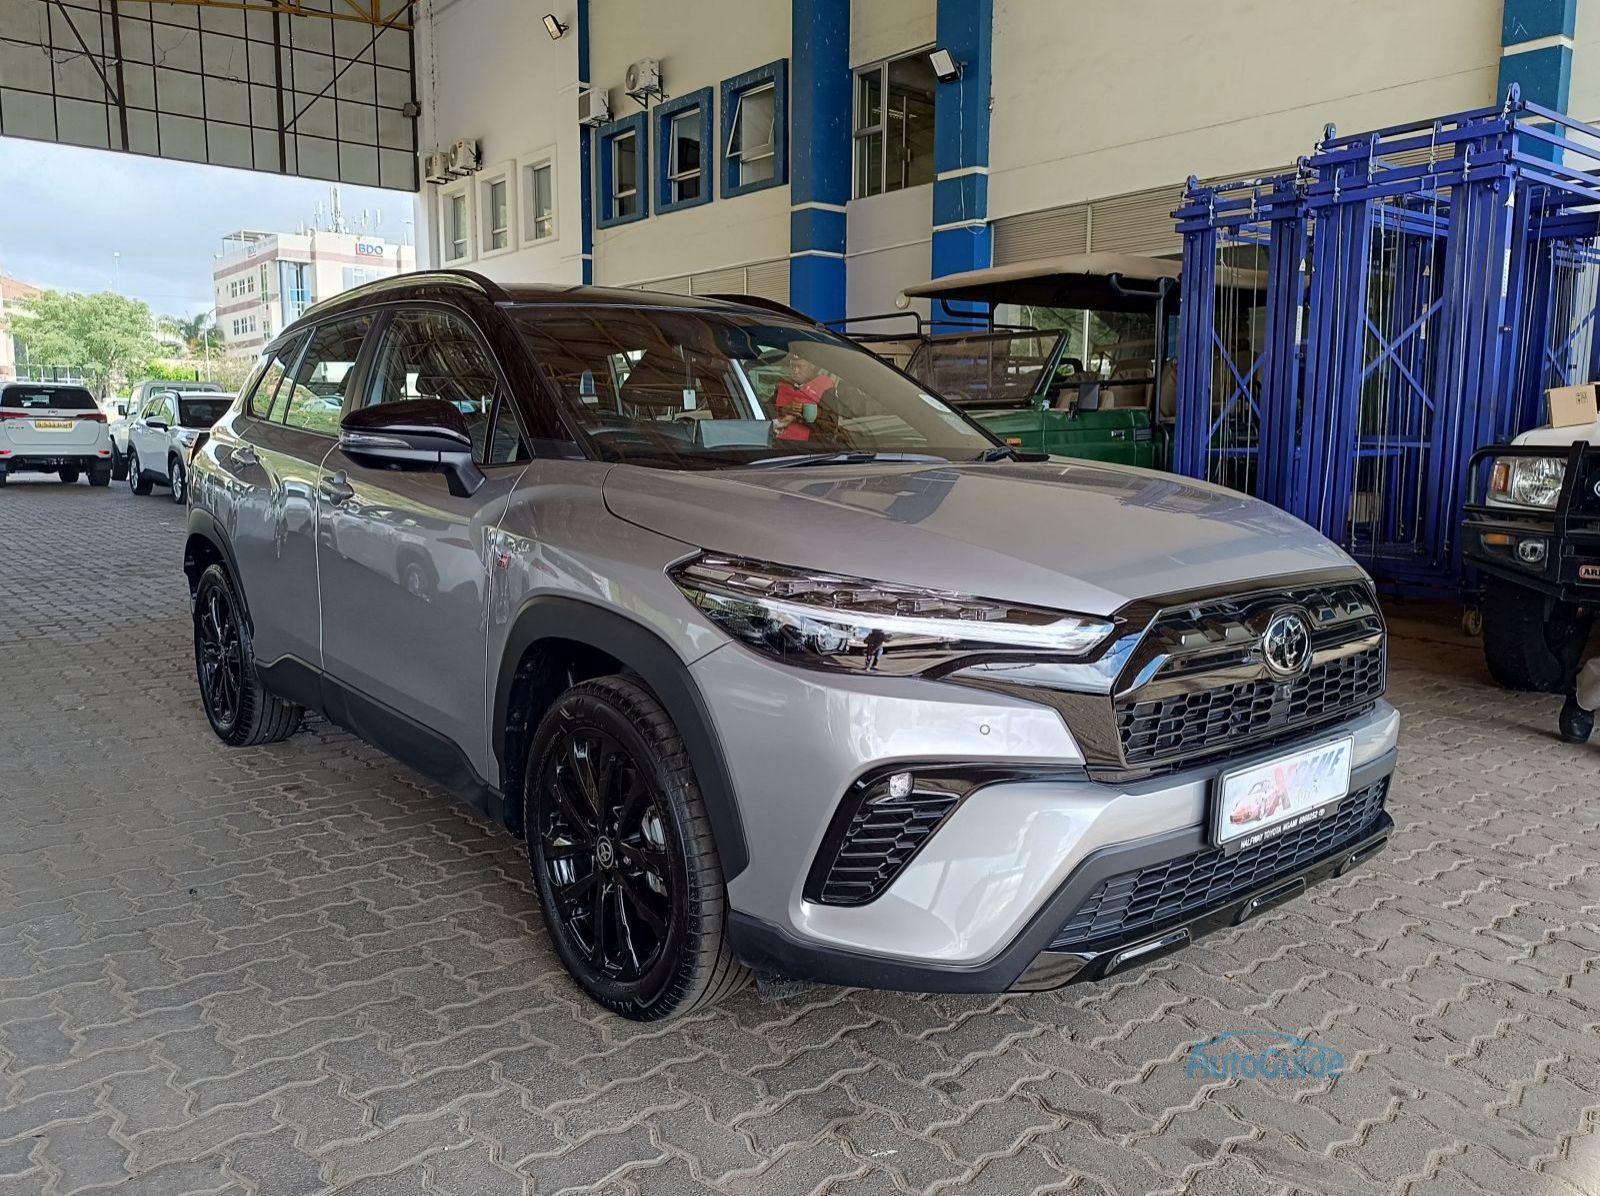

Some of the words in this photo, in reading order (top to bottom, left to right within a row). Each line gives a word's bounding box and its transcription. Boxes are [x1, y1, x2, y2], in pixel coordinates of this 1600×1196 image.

[357, 243, 384, 256] BDO
[1583, 568, 1600, 576] AR
[1263, 825, 1282, 840] TOYOTA
